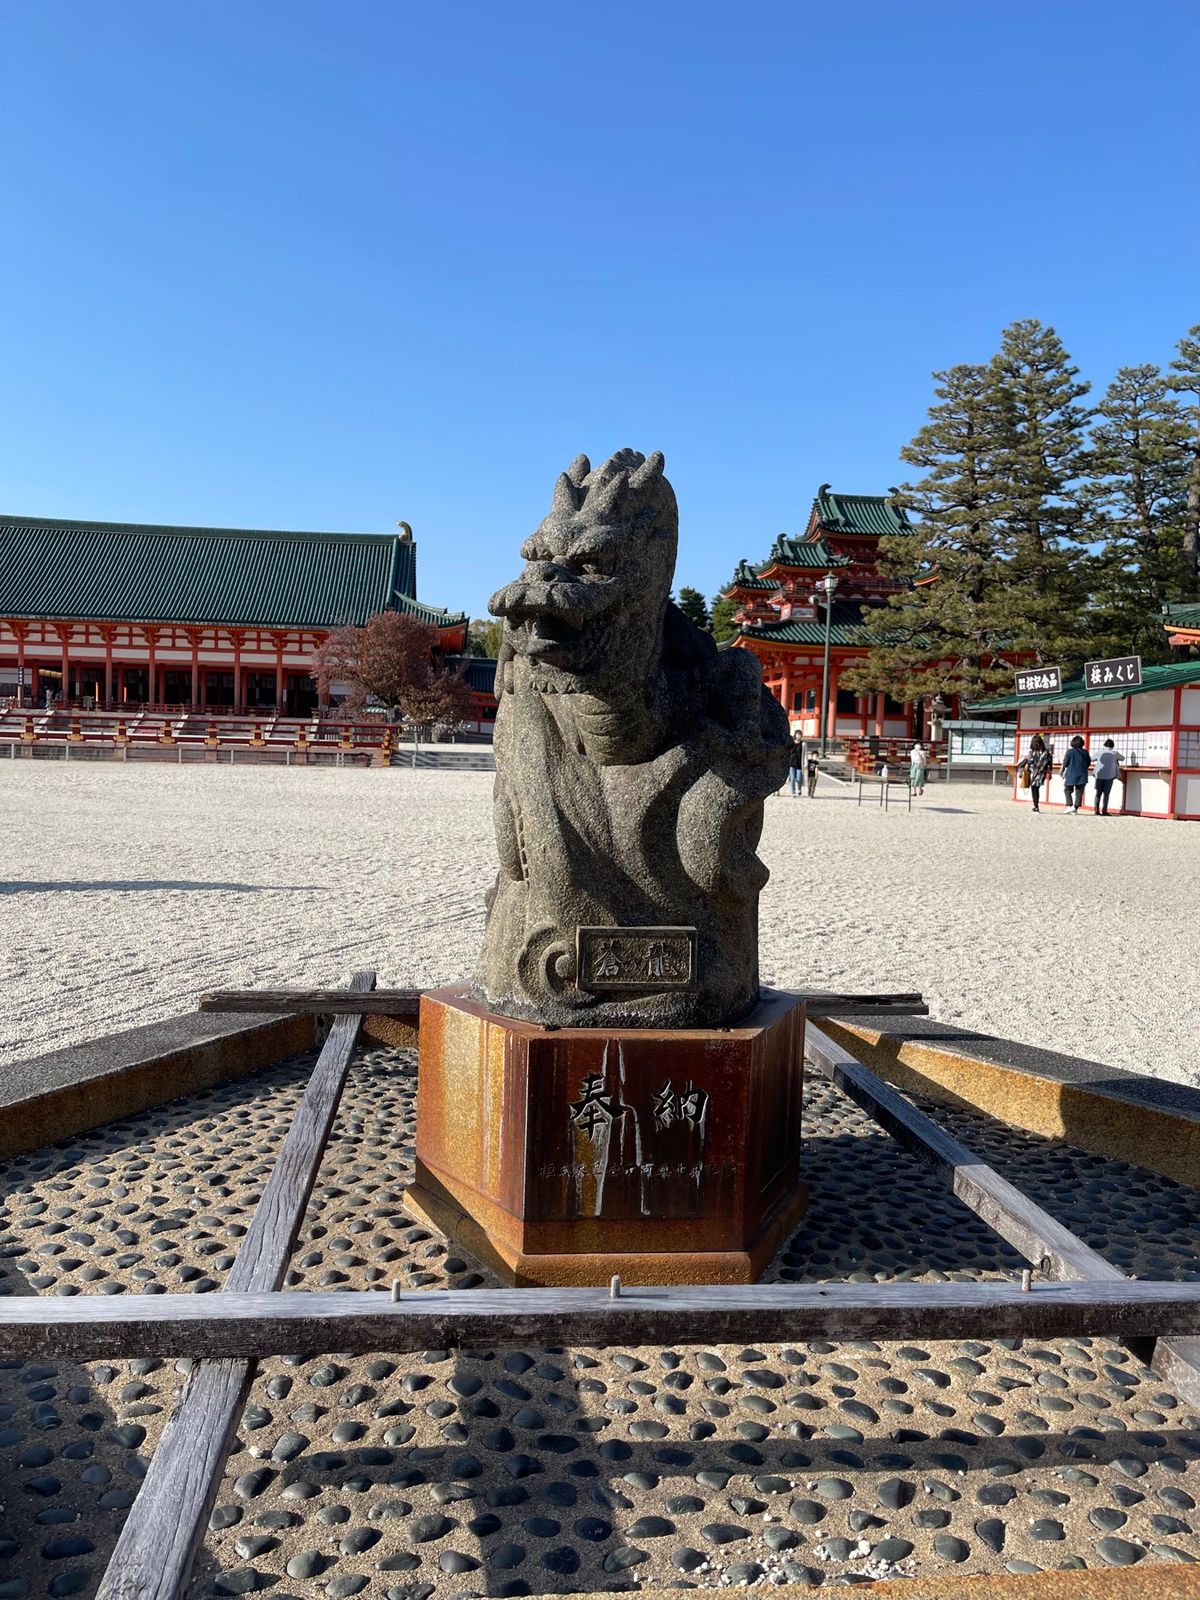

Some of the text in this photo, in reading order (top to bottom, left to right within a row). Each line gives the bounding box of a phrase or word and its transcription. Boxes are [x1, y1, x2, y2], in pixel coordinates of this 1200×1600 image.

[1090, 664, 1134, 684] 桜みくじ
[569, 1071, 709, 1142] 奉納
